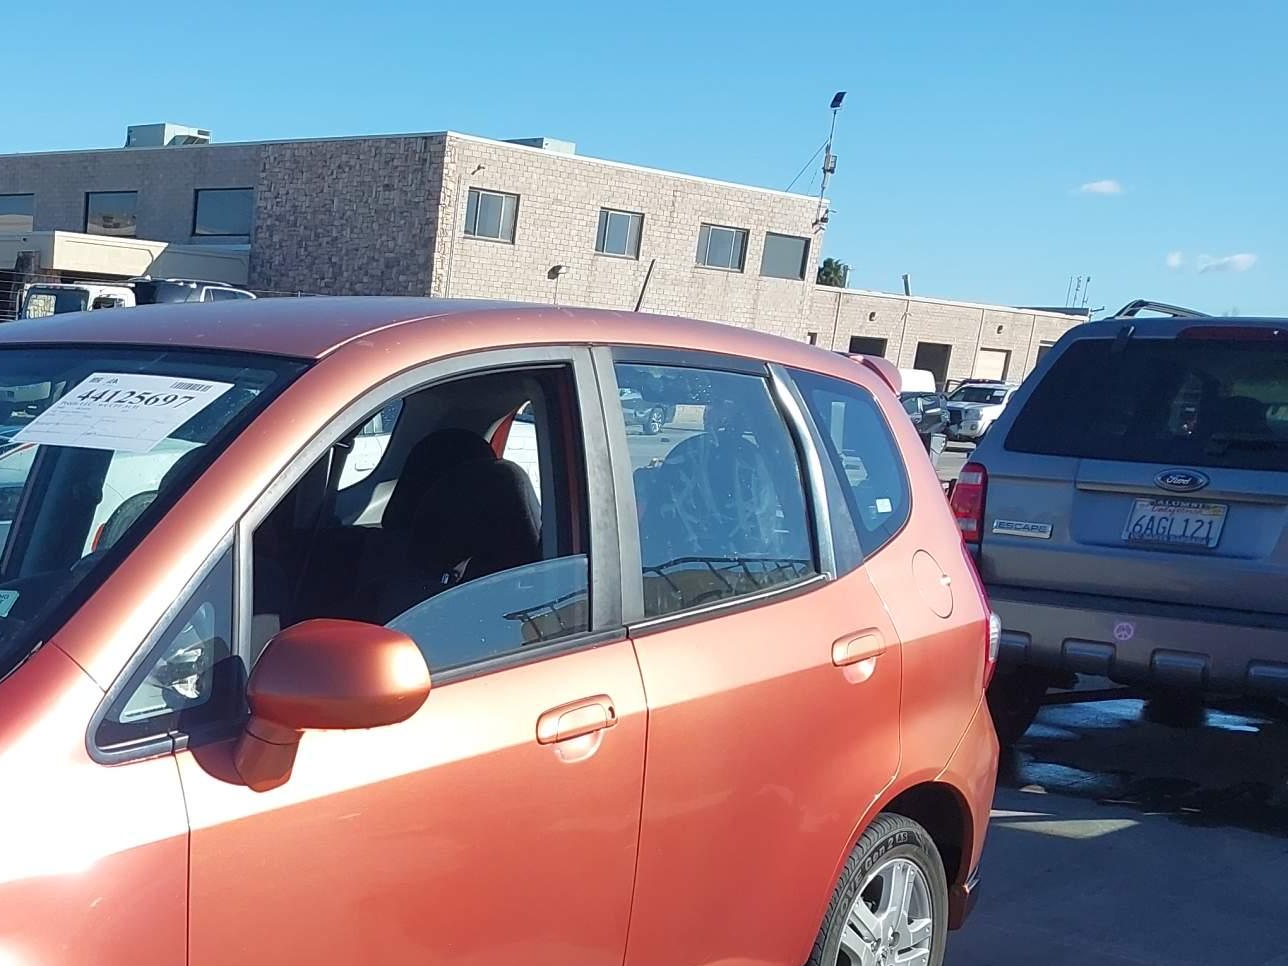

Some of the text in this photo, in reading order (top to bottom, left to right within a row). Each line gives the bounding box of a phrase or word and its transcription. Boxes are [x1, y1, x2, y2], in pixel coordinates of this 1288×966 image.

[77, 388, 196, 409] 44125697
[1166, 474, 1192, 485] Ford
[998, 521, 1050, 533] ESCAPE
